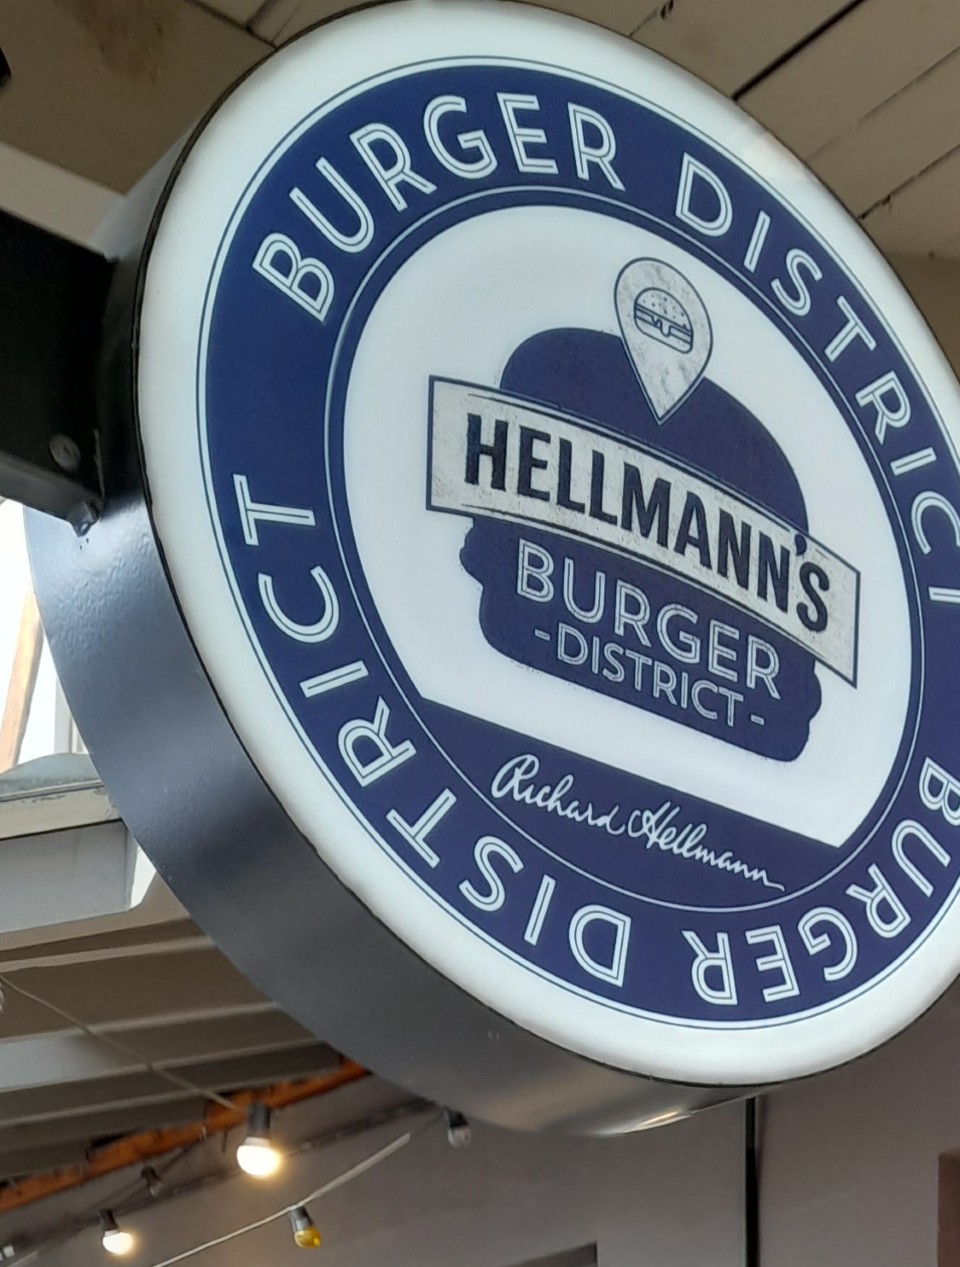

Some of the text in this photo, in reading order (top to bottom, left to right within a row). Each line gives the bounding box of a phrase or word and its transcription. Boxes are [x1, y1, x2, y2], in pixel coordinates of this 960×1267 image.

[252, 91, 625, 324] BURGER
[463, 413, 831, 633] HELLMANN'S
[516, 537, 781, 700] BURGER
[232, 473, 632, 988] DISTRICT
[491, 753, 786, 892] Richard Hellmann
